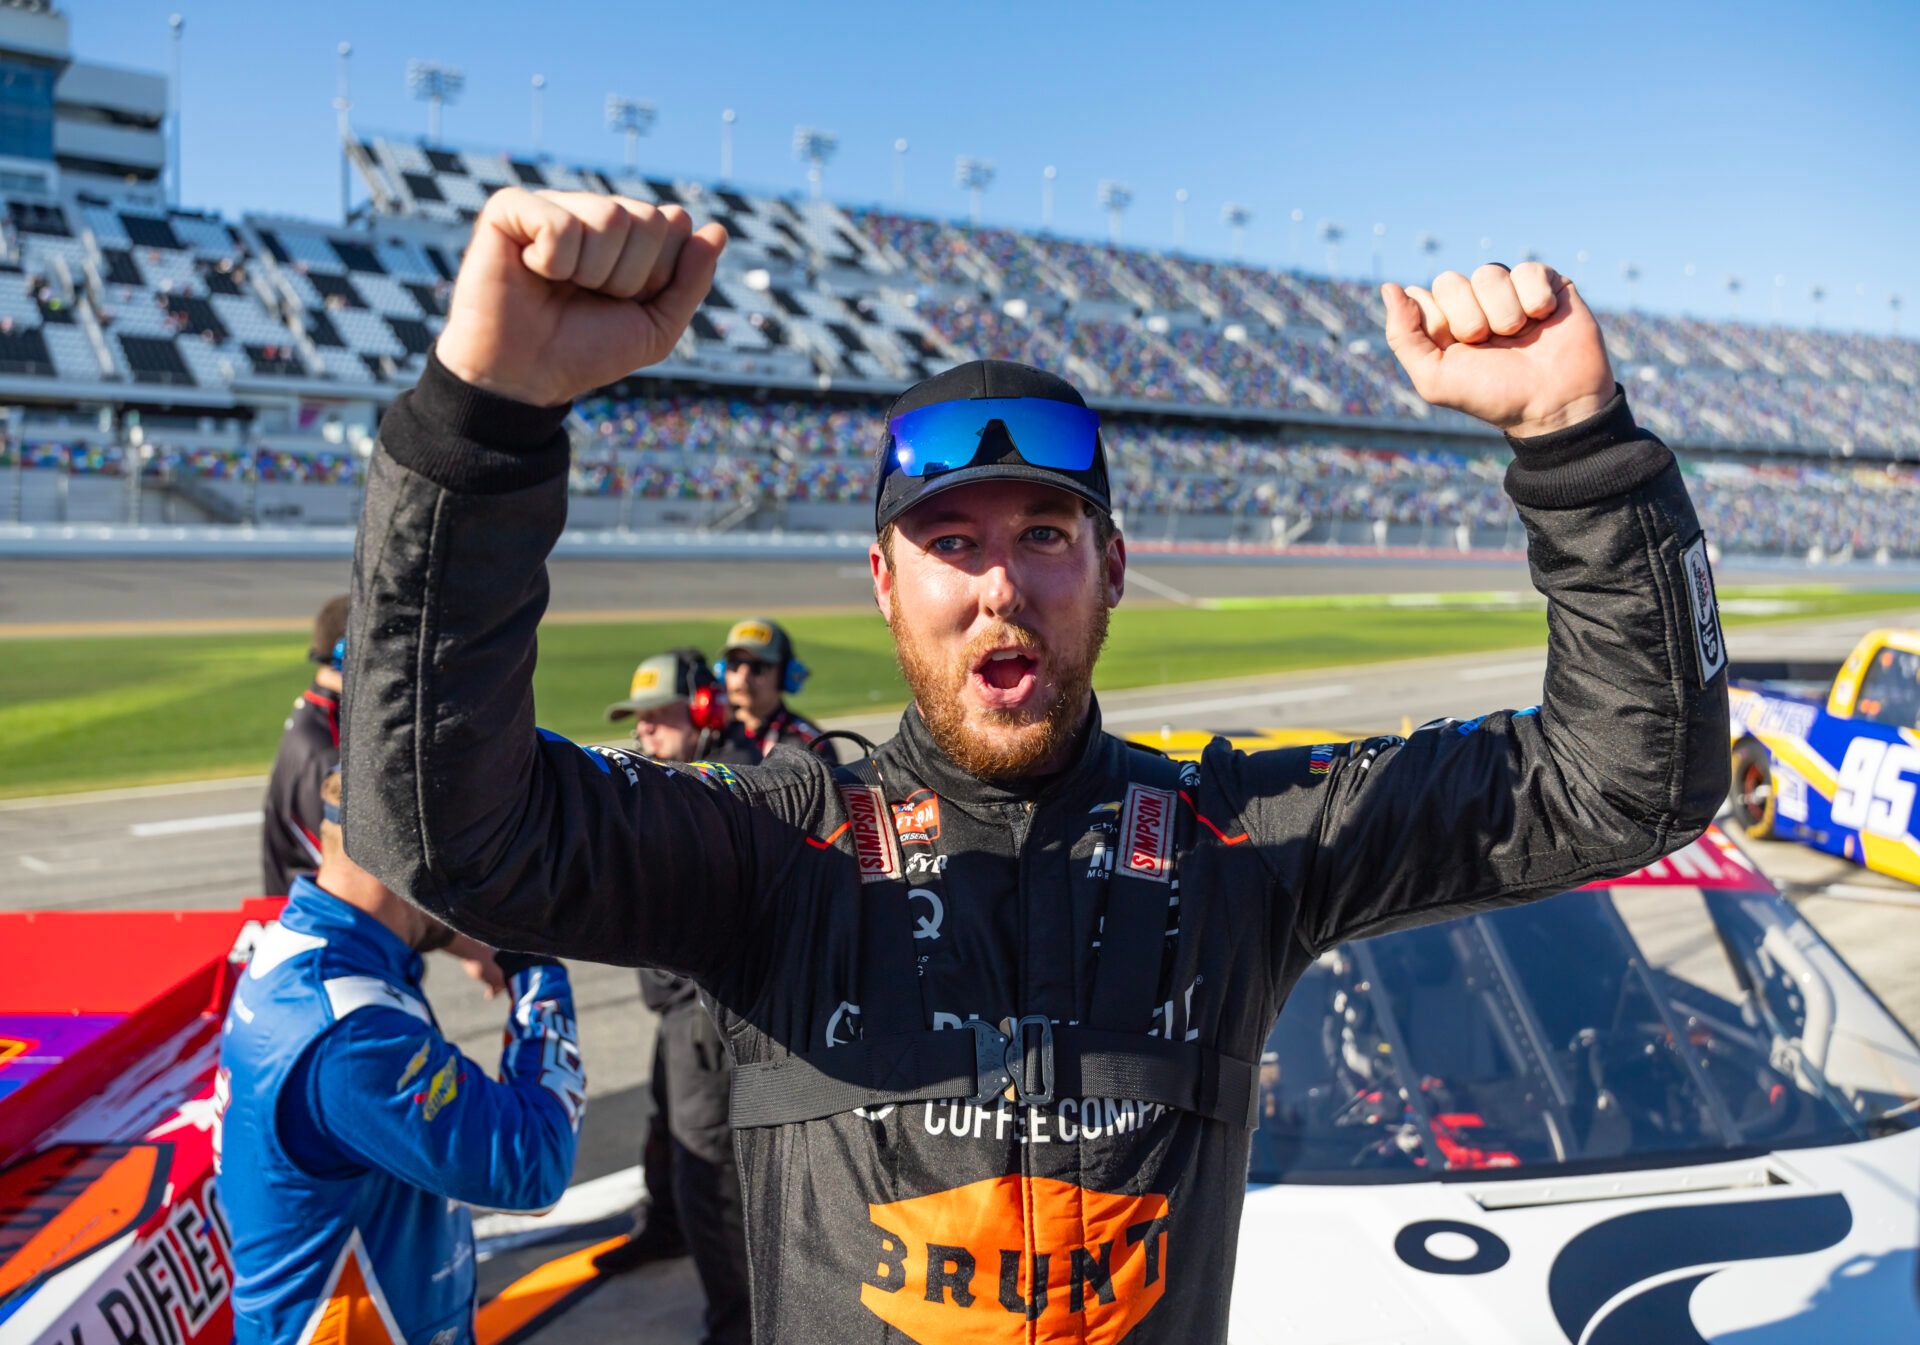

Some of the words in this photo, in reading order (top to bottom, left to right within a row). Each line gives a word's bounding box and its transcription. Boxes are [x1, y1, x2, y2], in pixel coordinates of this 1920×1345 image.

[851, 793, 885, 870] SIMPSON
[1831, 736, 1920, 838] 95
[1131, 795, 1163, 871] SIMPSON
[872, 1216, 1169, 1321] BRUNT
